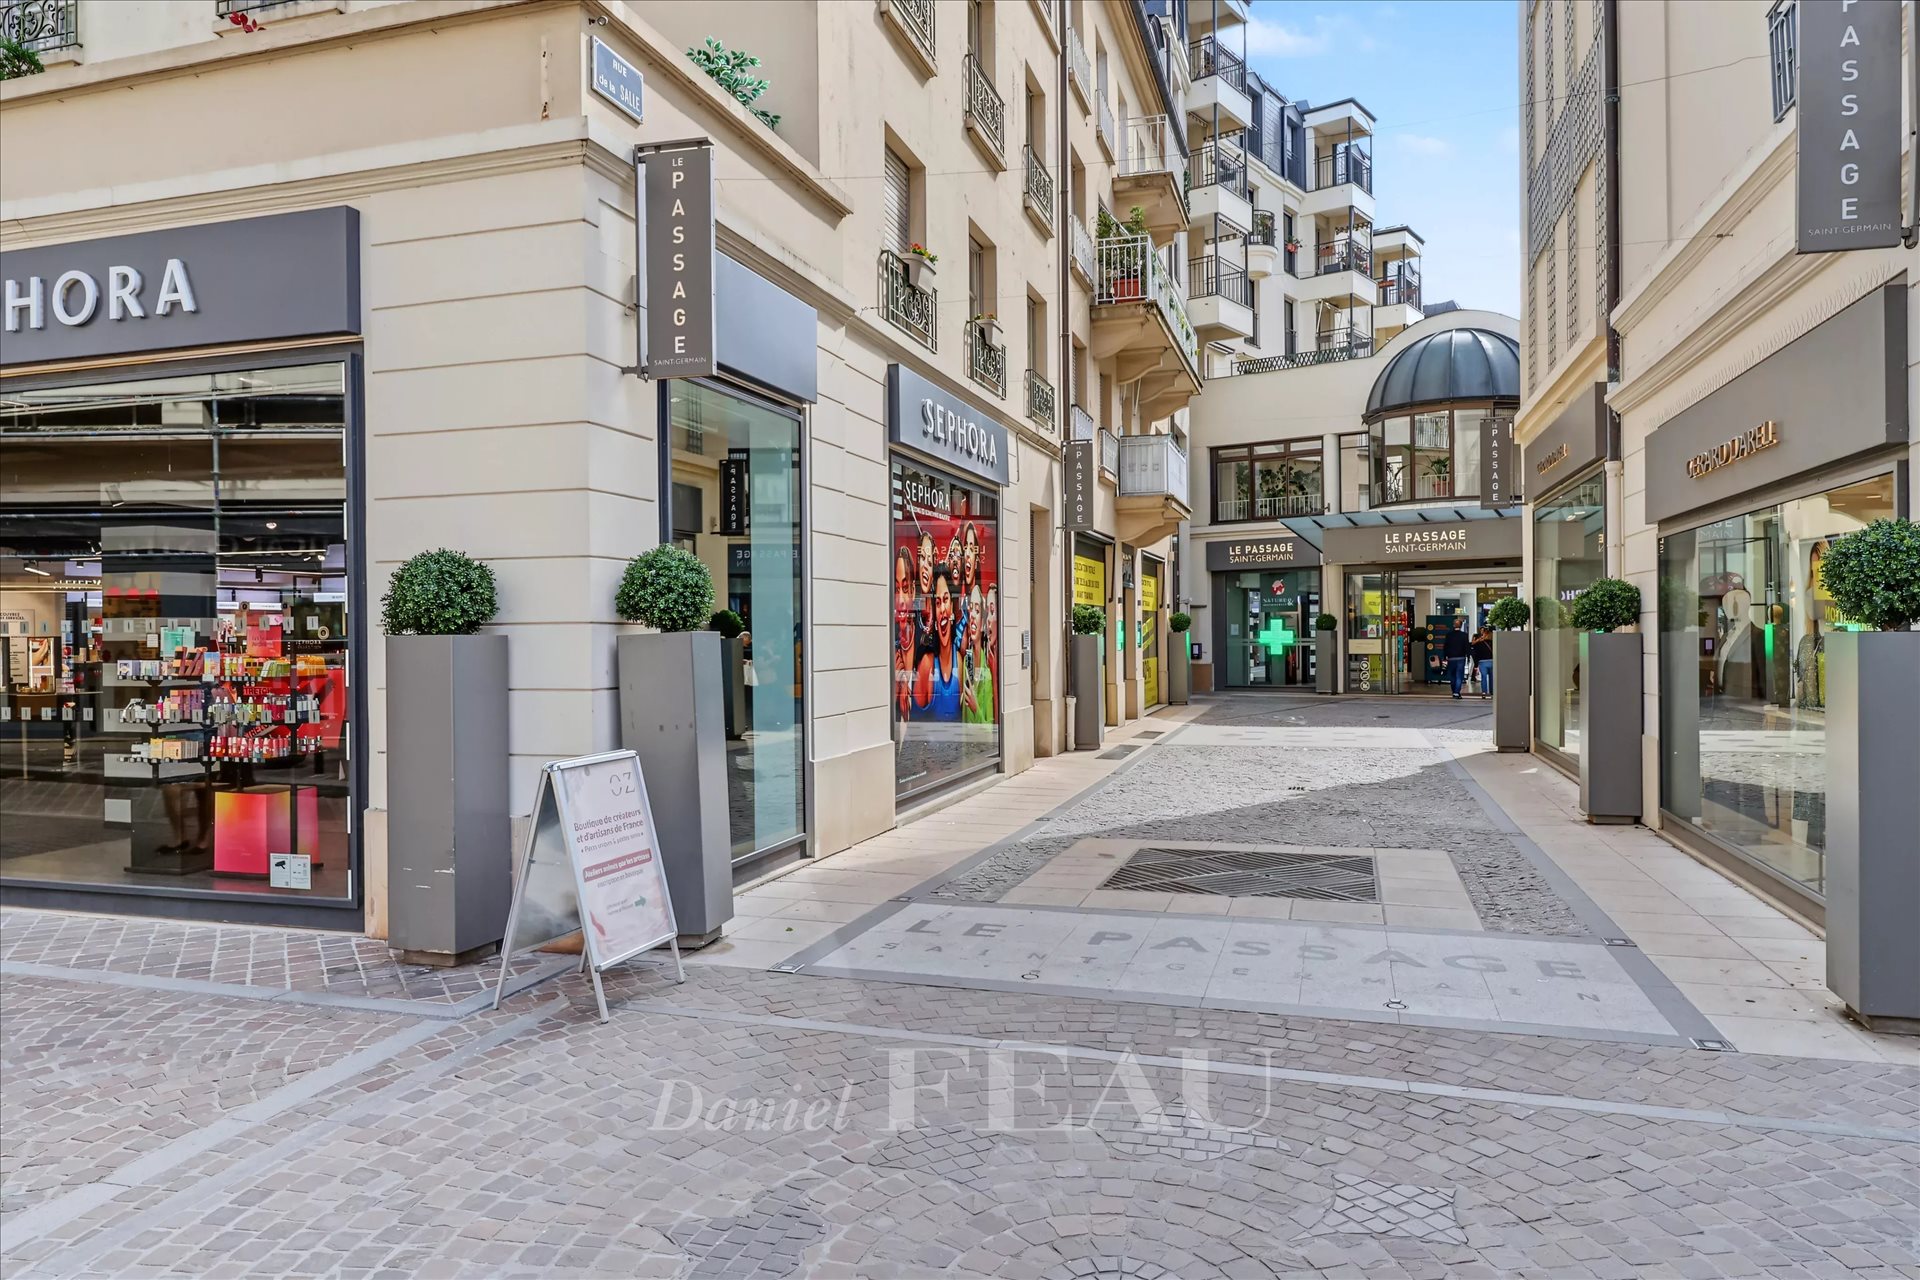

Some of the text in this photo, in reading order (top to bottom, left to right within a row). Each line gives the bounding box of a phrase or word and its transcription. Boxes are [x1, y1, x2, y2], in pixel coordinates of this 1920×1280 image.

[612, 58, 627, 77] RUE
[599, 74, 641, 112] de la SALLE
[672, 158, 684, 167] LE
[671, 171, 687, 354] PASSAGE
[5, 258, 197, 332] HORA
[922, 398, 998, 465] SEPHORA
[1491, 428, 1499, 501] PASSAGE
[905, 479, 951, 512] SEPHORA
[1385, 529, 1467, 544] LE PASSAGE
[1385, 541, 1467, 554] SAINT-GERMAIN
[1229, 543, 1294, 555] LE PASSAGE
[1229, 553, 1294, 564] SAINT-GERMAIN
[609, 772, 635, 796] OZ
[574, 809, 641, 832] Boutique de créateurs
[577, 834, 584, 843] et
[615, 824, 623, 833] de
[623, 819, 644, 831] France
[905, 919, 1586, 980] LE PASSAGE
